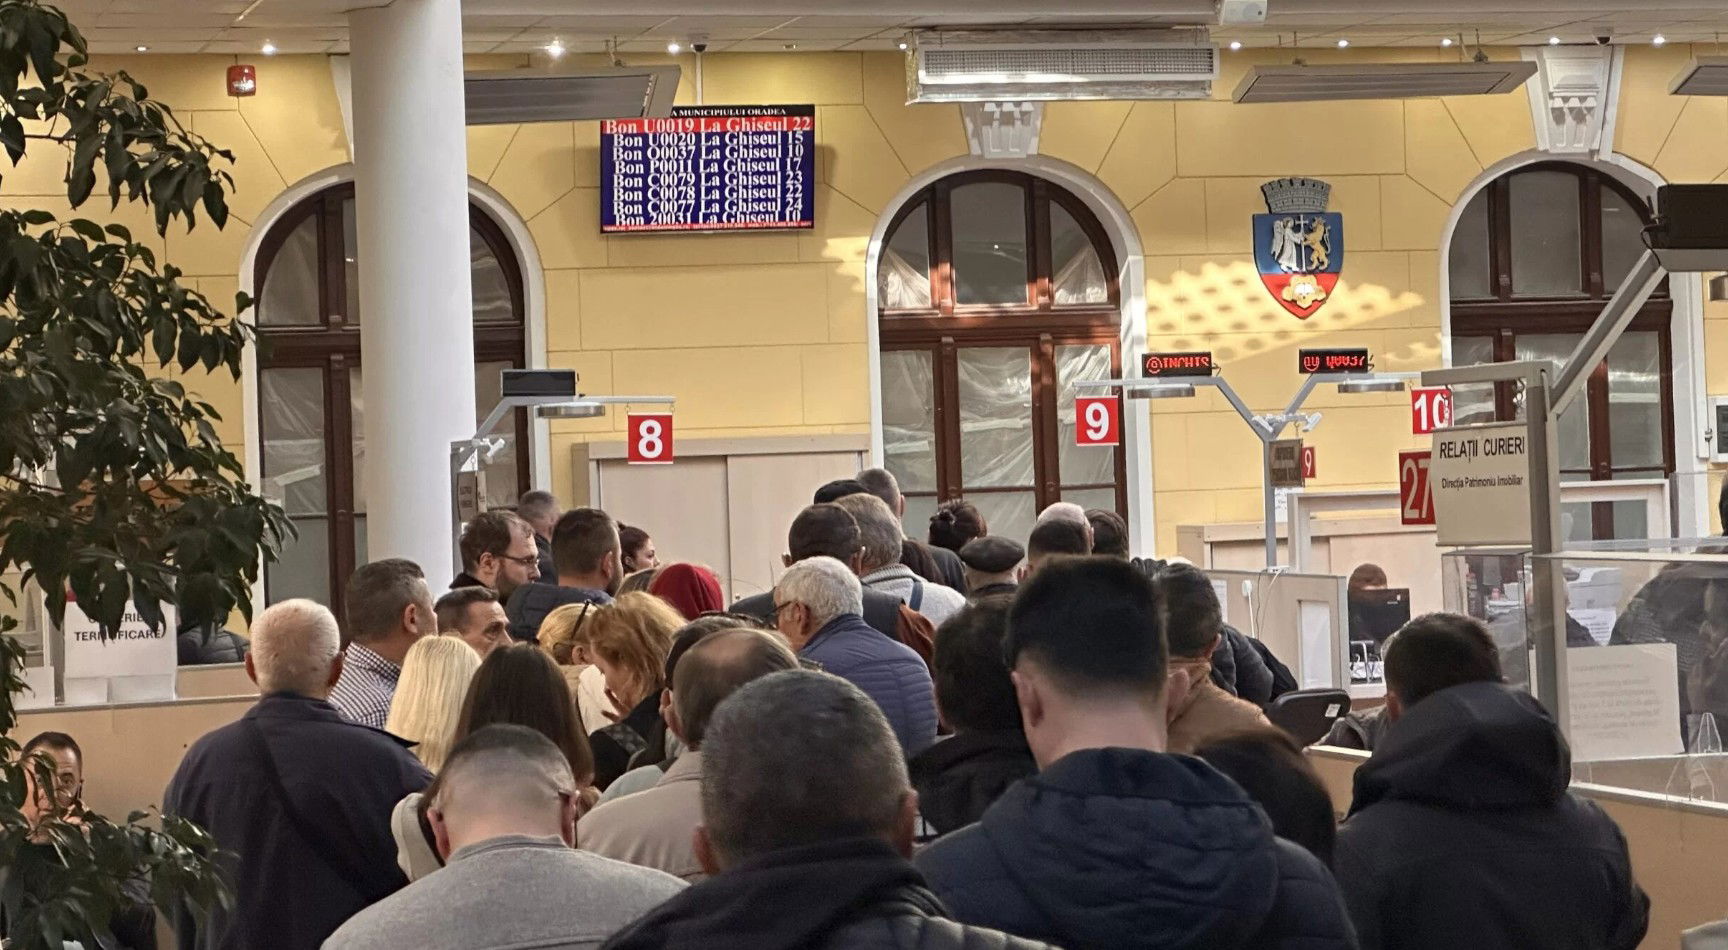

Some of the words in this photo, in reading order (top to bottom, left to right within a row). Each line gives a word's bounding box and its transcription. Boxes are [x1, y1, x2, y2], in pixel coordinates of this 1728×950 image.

[679, 108, 745, 116] MUNICIPIULUI
[606, 120, 636, 133] Bon
[644, 118, 694, 133] U0019
[700, 118, 720, 132] La
[726, 117, 788, 132] Ghiseul
[793, 117, 810, 130] 22
[614, 134, 642, 147] Bon
[648, 132, 696, 146] U0020
[701, 132, 720, 145] La
[725, 131, 781, 145] Ghiseul
[788, 131, 803, 144] 15
[614, 147, 642, 160] Bon
[702, 146, 720, 159] La
[726, 144, 781, 158] Ghiseul
[788, 144, 804, 158] 10
[615, 160, 644, 174] Bon
[650, 160, 692, 173] P0011
[700, 159, 718, 172] La
[724, 158, 779, 172] Ghiseul
[786, 158, 802, 171] 17
[614, 174, 642, 187] Bon
[648, 173, 695, 187] C0079
[701, 172, 720, 186] La
[724, 171, 781, 186] Ghiseul
[786, 171, 802, 184] 23
[614, 188, 642, 201] Bon
[648, 186, 695, 200] C0078
[701, 186, 720, 199] La
[724, 185, 781, 199] Ghiseul
[786, 184, 802, 198] 22
[614, 201, 642, 215] Bon
[648, 200, 695, 214] C0077
[701, 200, 720, 213] La
[724, 198, 781, 212] Ghiseul
[786, 198, 802, 211] 24
[615, 214, 644, 226] Bon
[699, 212, 718, 224] La
[723, 211, 778, 223] Ghiseul
[786, 210, 800, 222] 10
[1414, 392, 1449, 431] 10
[1085, 402, 1109, 440] 9
[638, 419, 663, 459] 8
[1484, 436, 1524, 456] CURIERI
[1402, 457, 1431, 519] 27
[1465, 476, 1496, 488] Patrimoniu
[1498, 475, 1523, 486] Imobiliar
